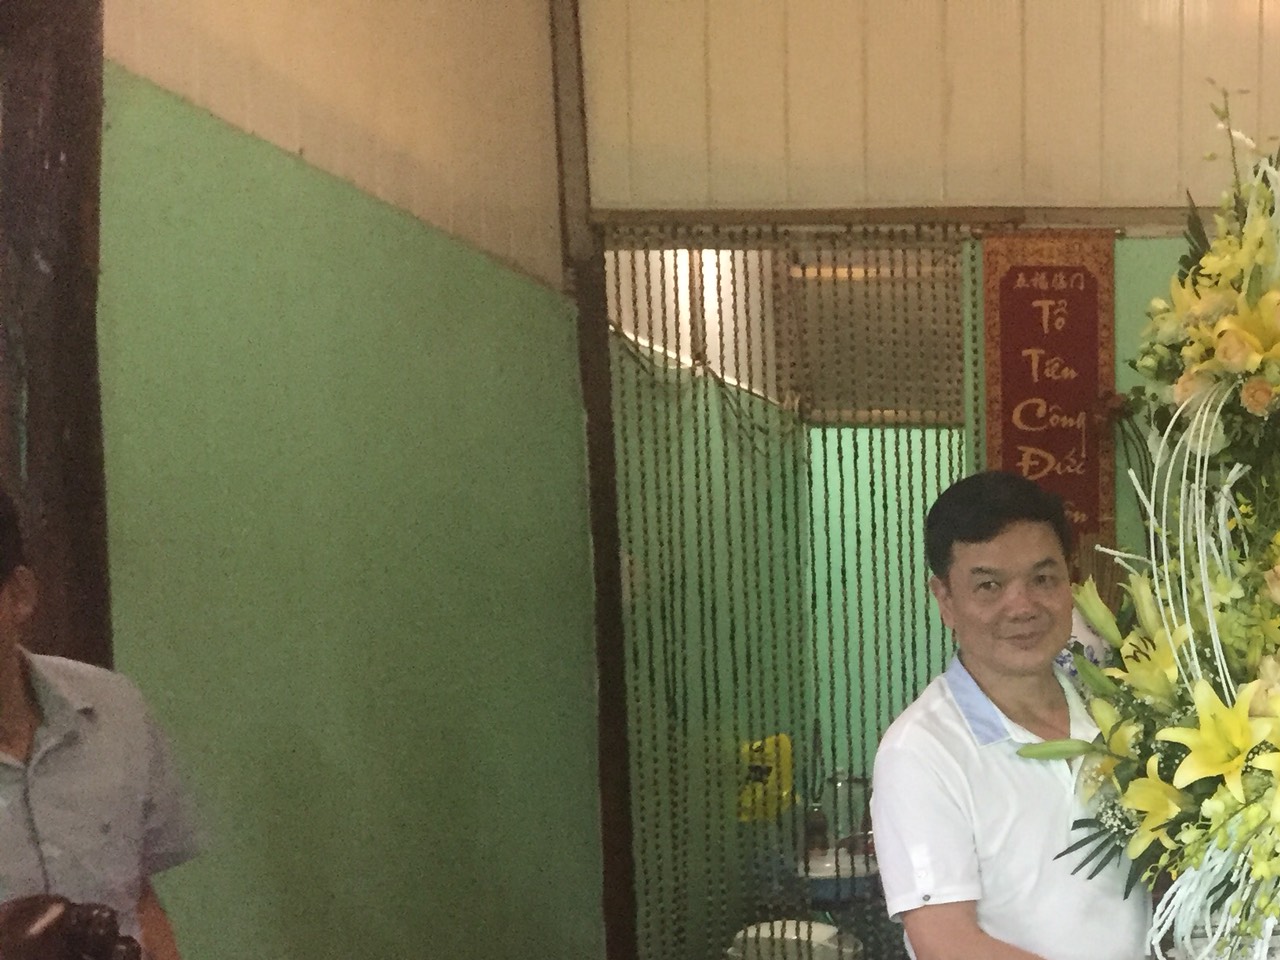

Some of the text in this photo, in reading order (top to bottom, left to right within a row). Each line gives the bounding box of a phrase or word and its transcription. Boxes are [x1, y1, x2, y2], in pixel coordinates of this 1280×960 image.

[1031, 299, 1068, 334] Tổ
[1011, 398, 1086, 459] Công
[1016, 445, 1086, 480] Đức
